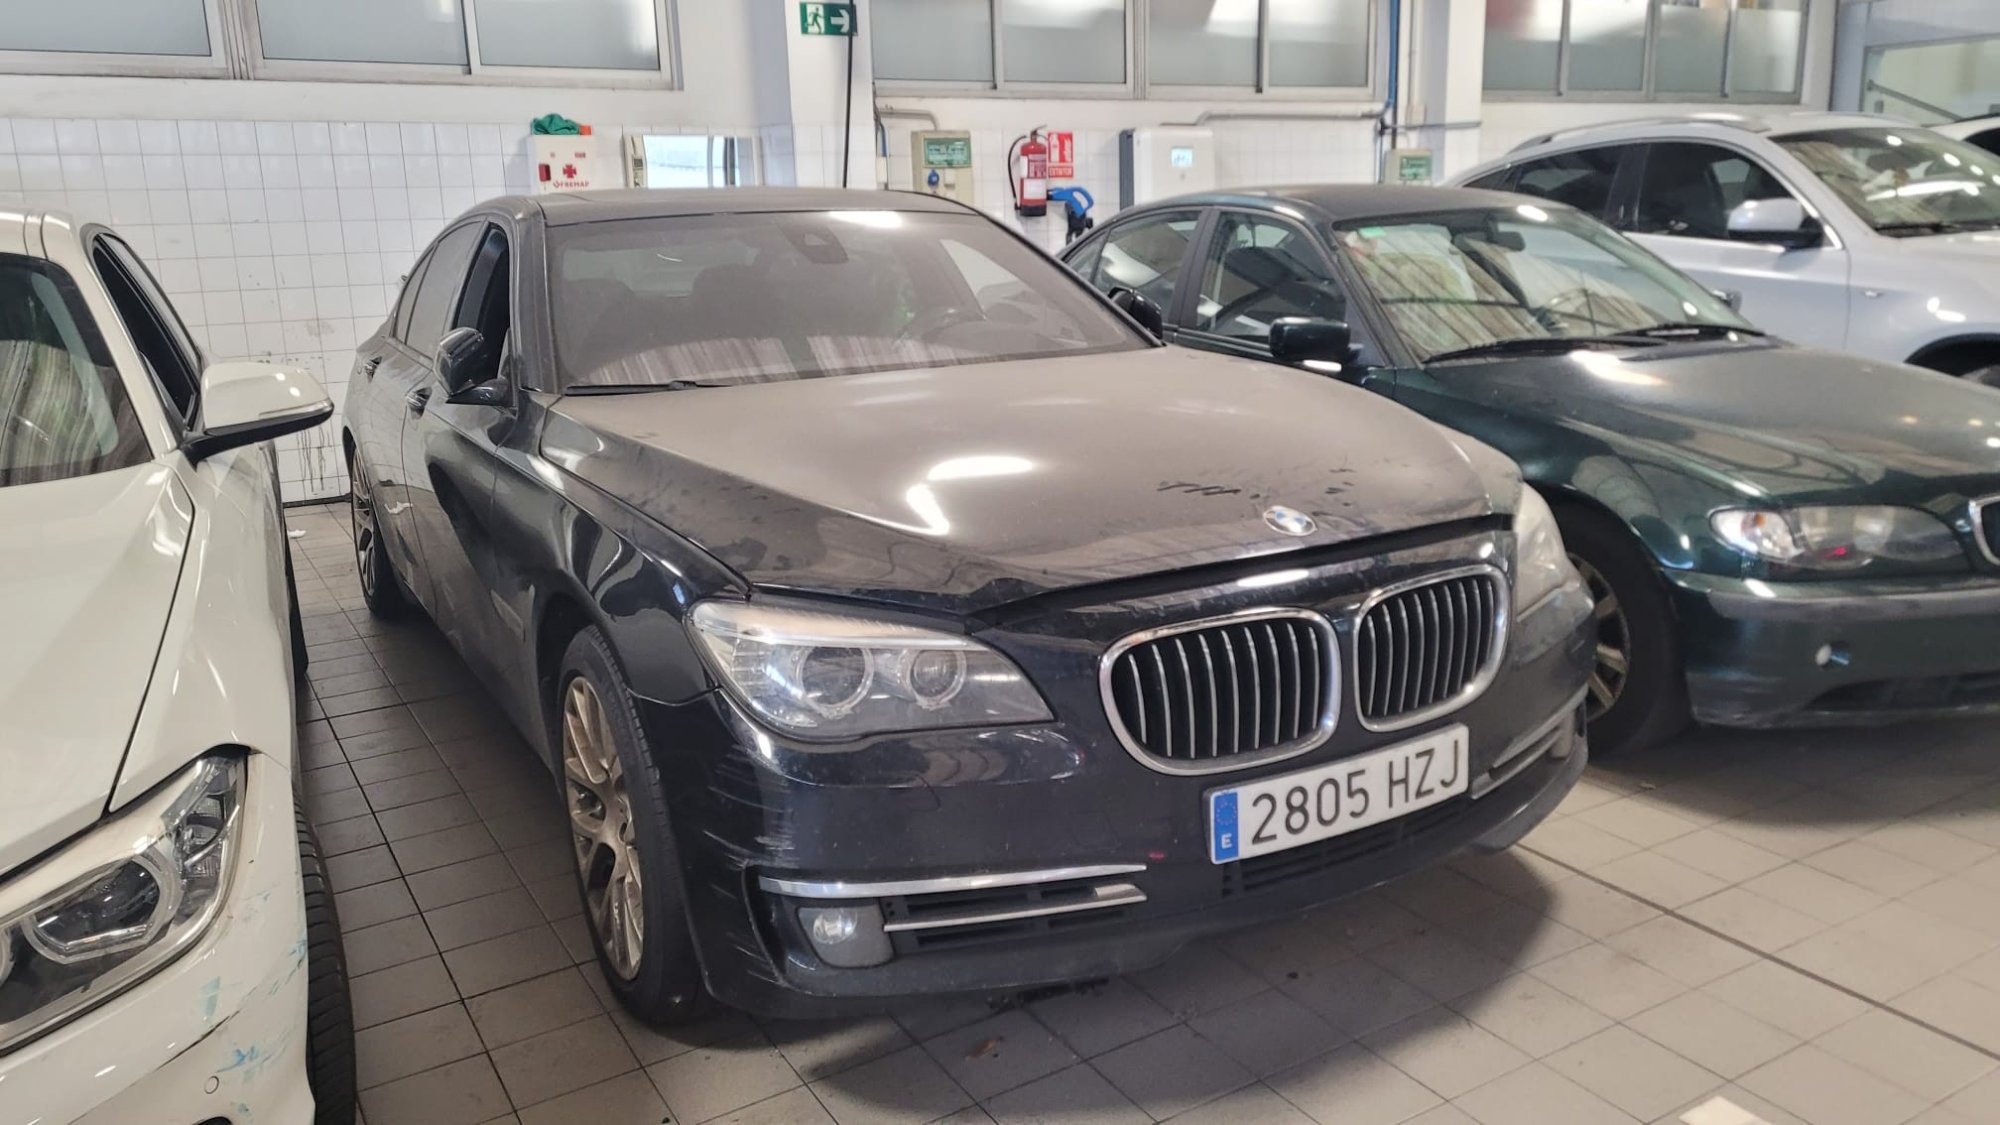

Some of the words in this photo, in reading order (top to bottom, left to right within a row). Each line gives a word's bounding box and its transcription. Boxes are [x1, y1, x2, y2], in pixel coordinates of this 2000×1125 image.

[1251, 769, 1369, 845] 2805
[1388, 739, 1459, 808] HZJ
[1221, 833, 1232, 848] E
